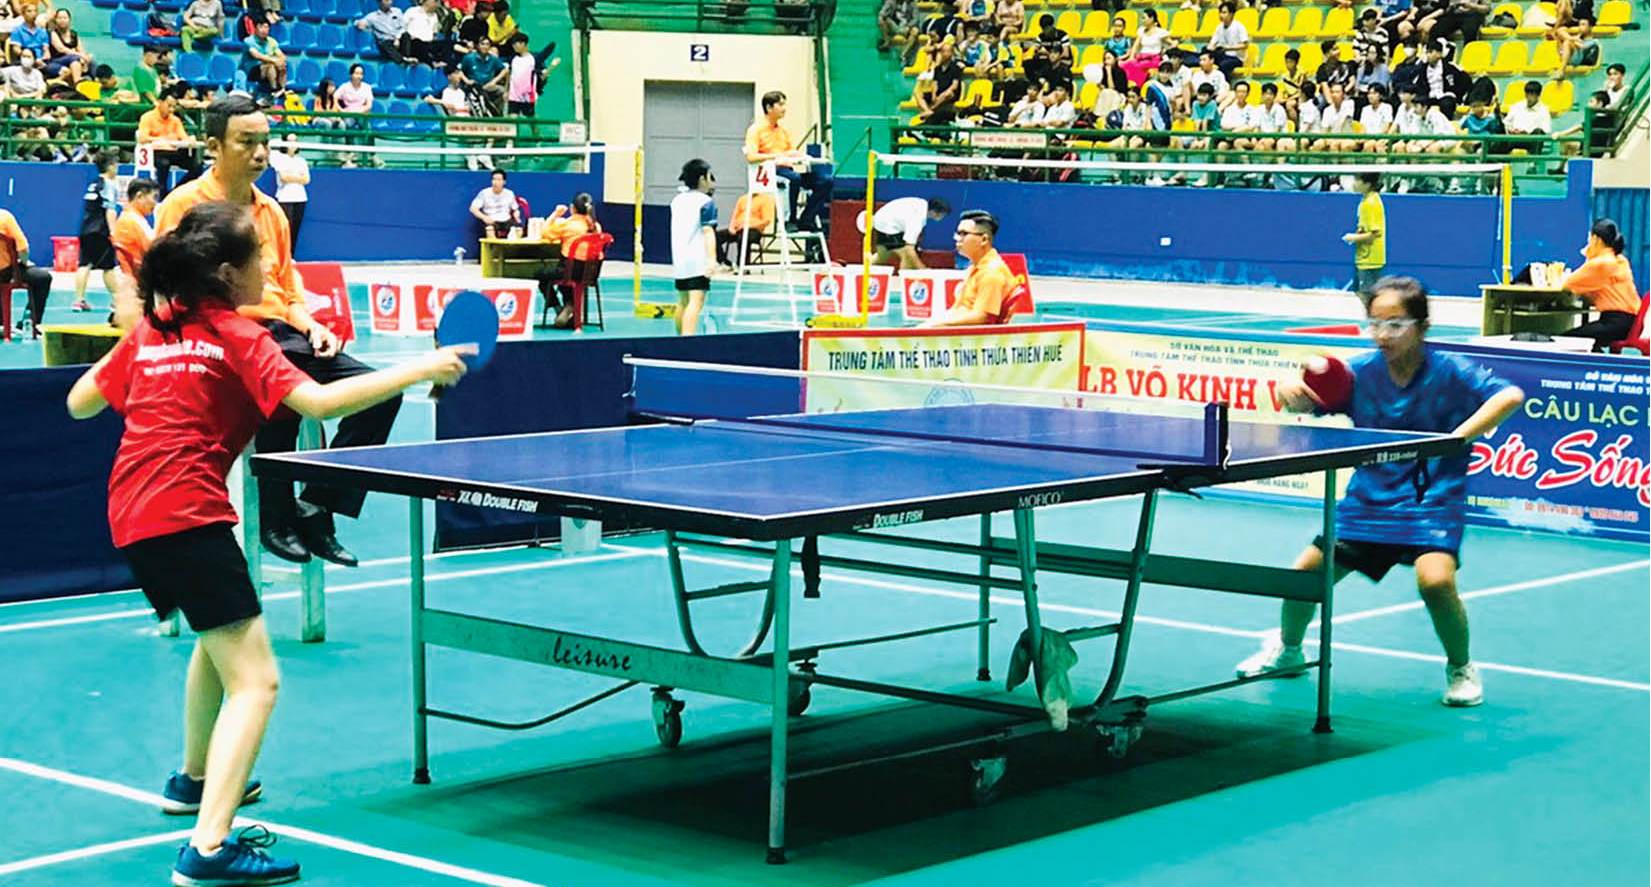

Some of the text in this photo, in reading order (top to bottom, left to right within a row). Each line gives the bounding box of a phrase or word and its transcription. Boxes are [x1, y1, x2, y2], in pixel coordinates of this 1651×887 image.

[692, 45, 707, 60] 2
[140, 148, 148, 166] 3
[756, 166, 769, 187] 4
[829, 351, 867, 370] TRUNG
[922, 350, 950, 369] THAO
[1256, 347, 1279, 357] THAO
[1126, 364, 1168, 398] VÕ
[1177, 373, 1257, 411] KINH
[1524, 395, 1581, 422] CÂU
[1589, 402, 1639, 428] LẠC
[483, 493, 538, 513] DOUBLE FISH
[873, 512, 905, 529] DOUBLE
[553, 636, 632, 671] leisure
